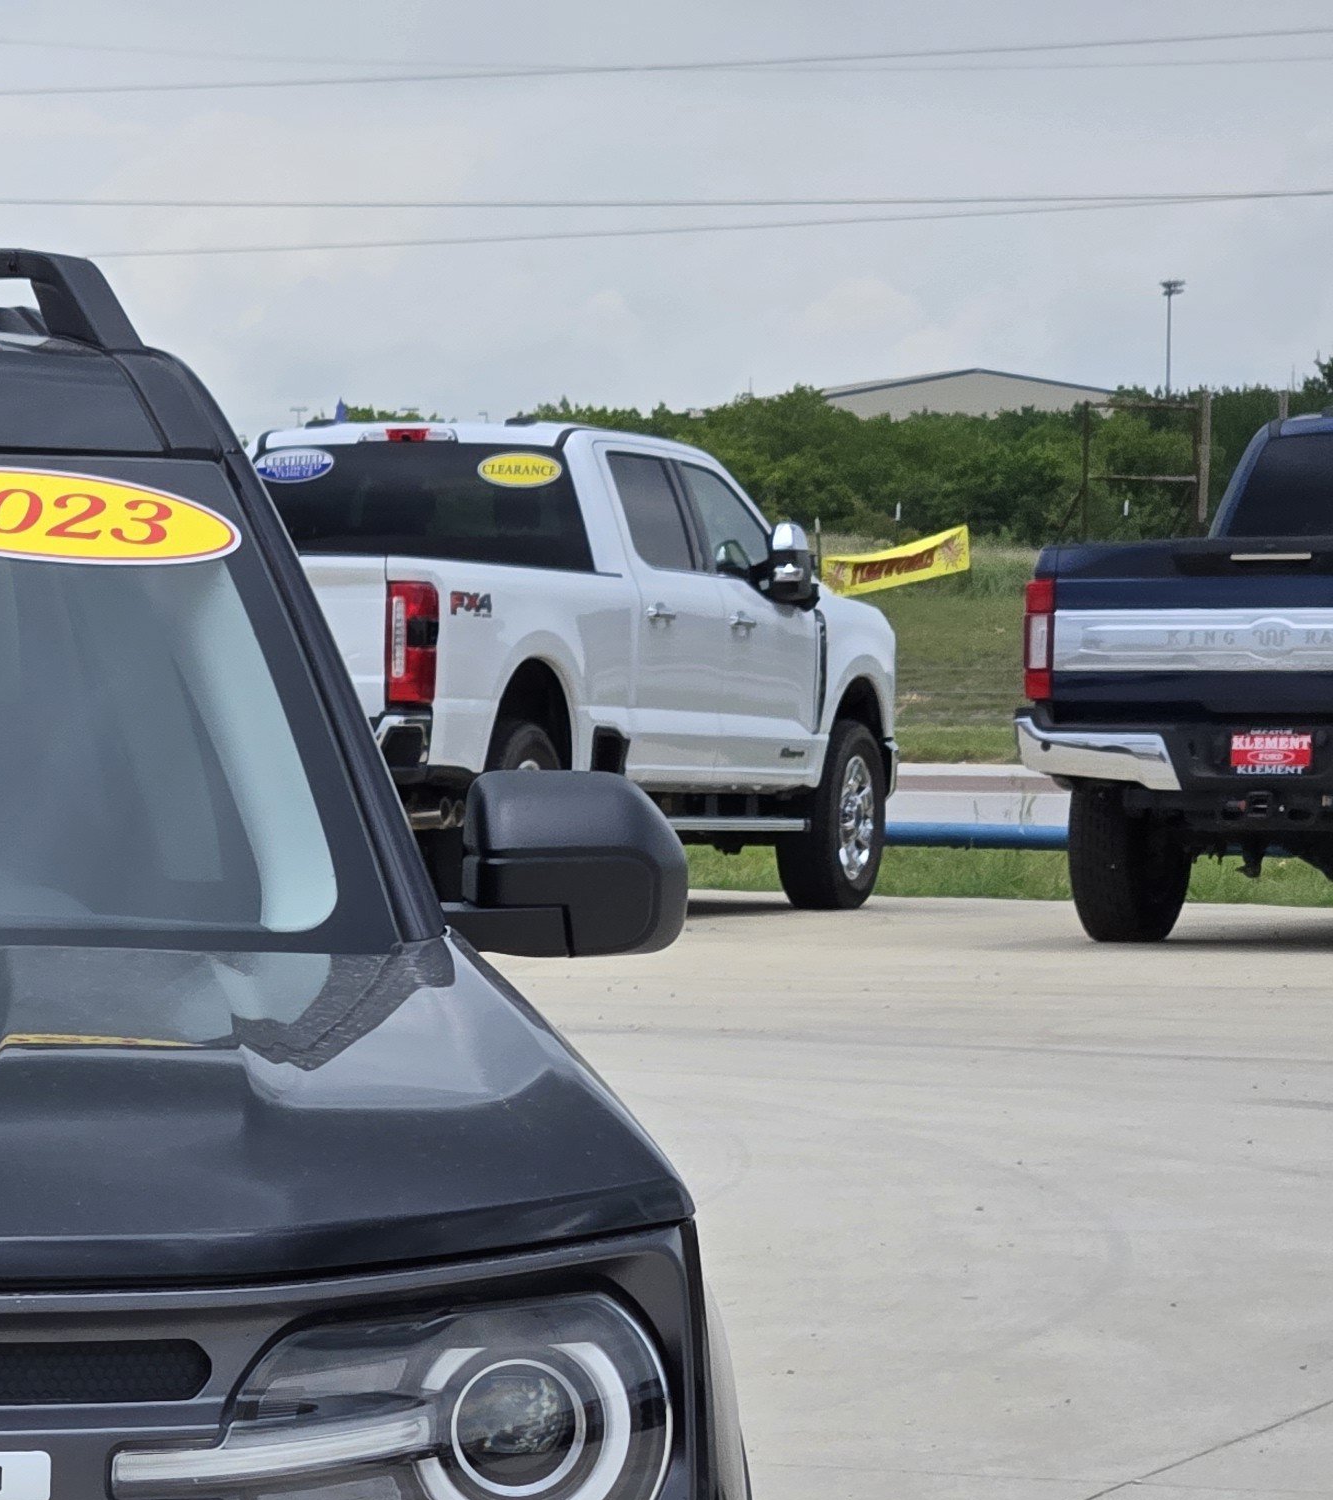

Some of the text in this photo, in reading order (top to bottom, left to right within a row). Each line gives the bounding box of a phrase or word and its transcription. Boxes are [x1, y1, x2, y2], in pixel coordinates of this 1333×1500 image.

[482, 464, 557, 477] CLEARANCE
[450, 590, 492, 615] FX4
[1167, 629, 1235, 646] KING
[1231, 734, 1312, 750] KLEMENT
[1236, 764, 1306, 775] KLEMENT
